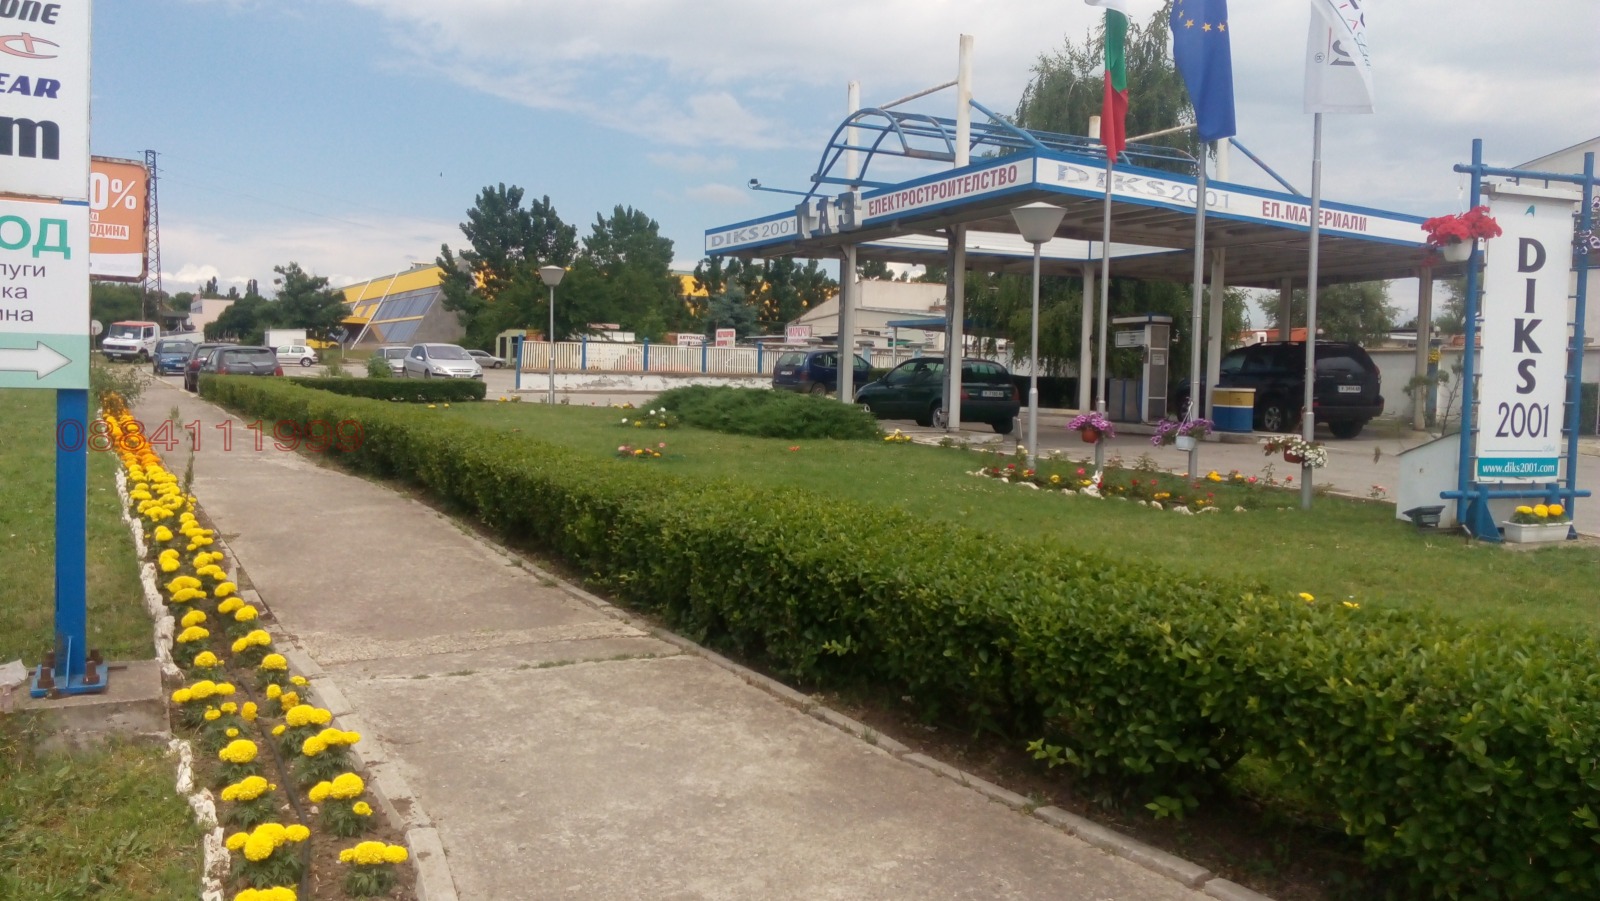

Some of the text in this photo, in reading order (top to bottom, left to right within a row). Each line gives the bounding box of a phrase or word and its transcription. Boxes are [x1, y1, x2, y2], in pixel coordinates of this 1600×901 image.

[868, 165, 1018, 217] ЕЛЕКТРОСТРОИТЕЛСТВО
[1262, 201, 1367, 231] ЕЛ.МАЕРИАЛИ
[2, 286, 28, 299] ка
[1512, 236, 1547, 394] DIKS
[1495, 401, 1550, 438] 2001
[1482, 461, 1555, 473] www.diks2001.com
